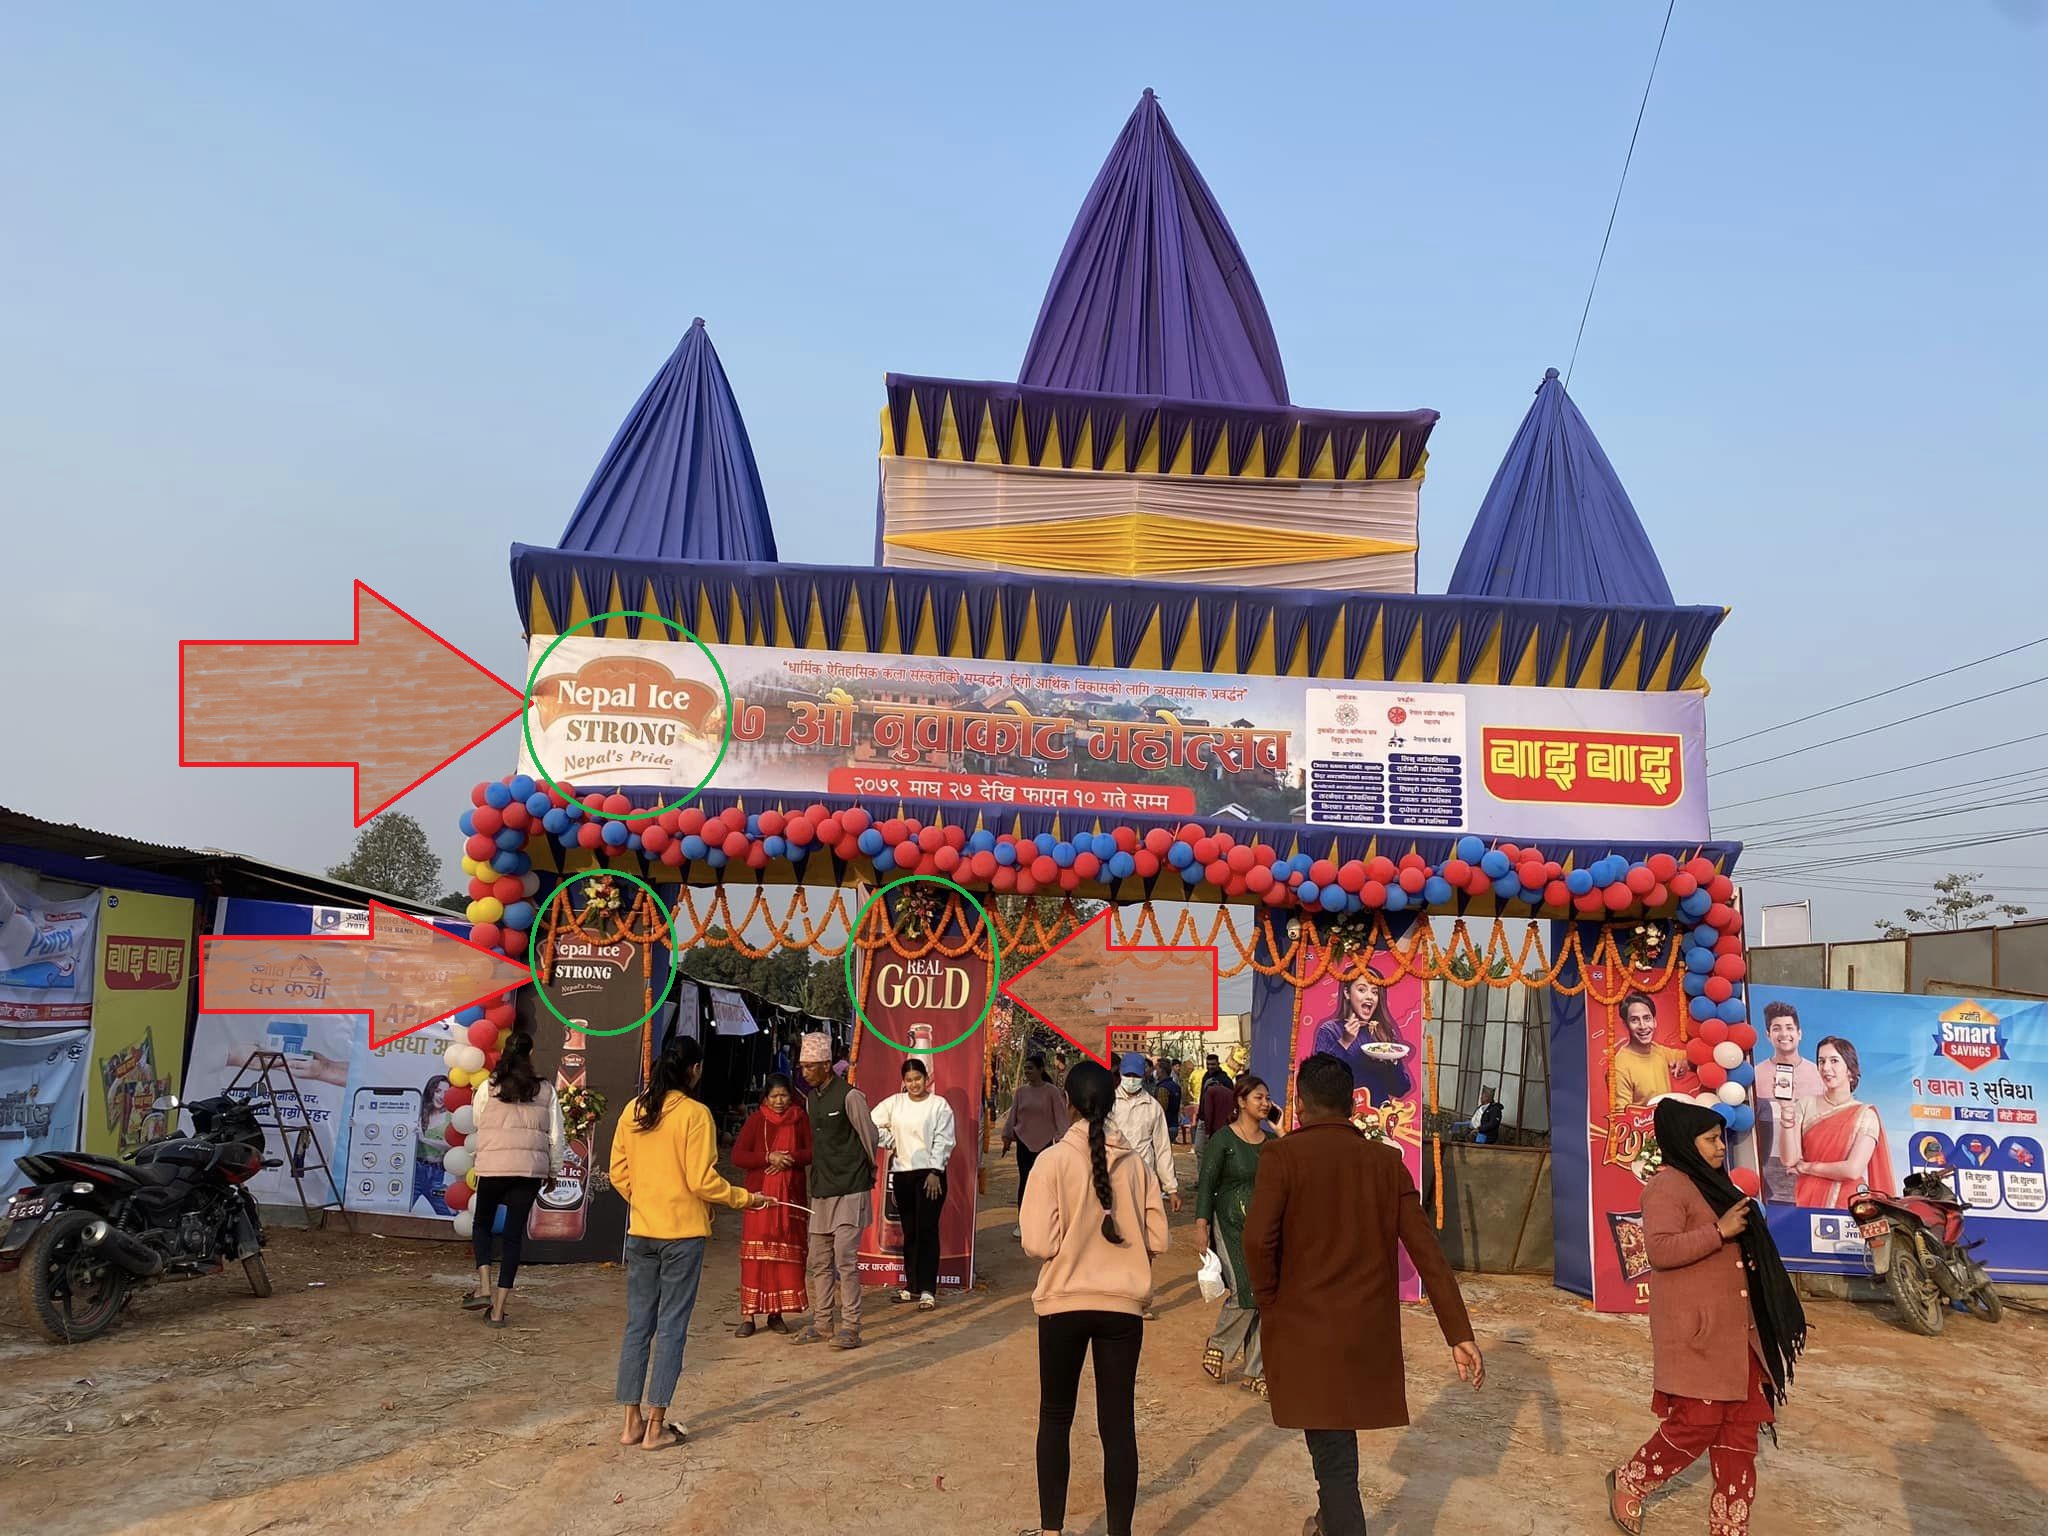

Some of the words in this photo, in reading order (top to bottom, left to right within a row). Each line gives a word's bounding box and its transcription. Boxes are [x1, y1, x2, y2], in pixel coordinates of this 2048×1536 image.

[826, 662, 878, 679] ऐतिहासिक
[883, 666, 906, 680] कला
[1010, 673, 1031, 689] दिगो
[1035, 674, 1070, 691] आर्थिक
[1075, 677, 1122, 695] विकासको
[1125, 682, 1150, 697] लागि
[557, 679, 637, 712] Nepal
[647, 684, 691, 710] Ice
[566, 719, 677, 746] STRONG
[732, 697, 766, 742] ७
[872, 700, 1074, 764] नुवाकोट
[1087, 708, 1292, 774] महोत्सव
[564, 749, 624, 772] Nepal's
[630, 750, 674, 766] Pride
[853, 776, 901, 796] २०७९
[908, 779, 942, 798] माघ
[949, 781, 972, 798] २७
[978, 780, 1014, 803] देखि
[1073, 789, 1095, 807] १०
[1102, 786, 1126, 809] गते
[1133, 793, 1169, 812] सम्म
[555, 964, 613, 980] STRONG
[907, 959, 944, 976] REAL
[1941, 1022, 1997, 1044] Smart
[1951, 1045, 1992, 1058] SAVINGS
[1927, 1078, 1965, 1098] खाता
[1968, 1081, 1979, 1101] ३
[1983, 1076, 2034, 1105] सुविधा
